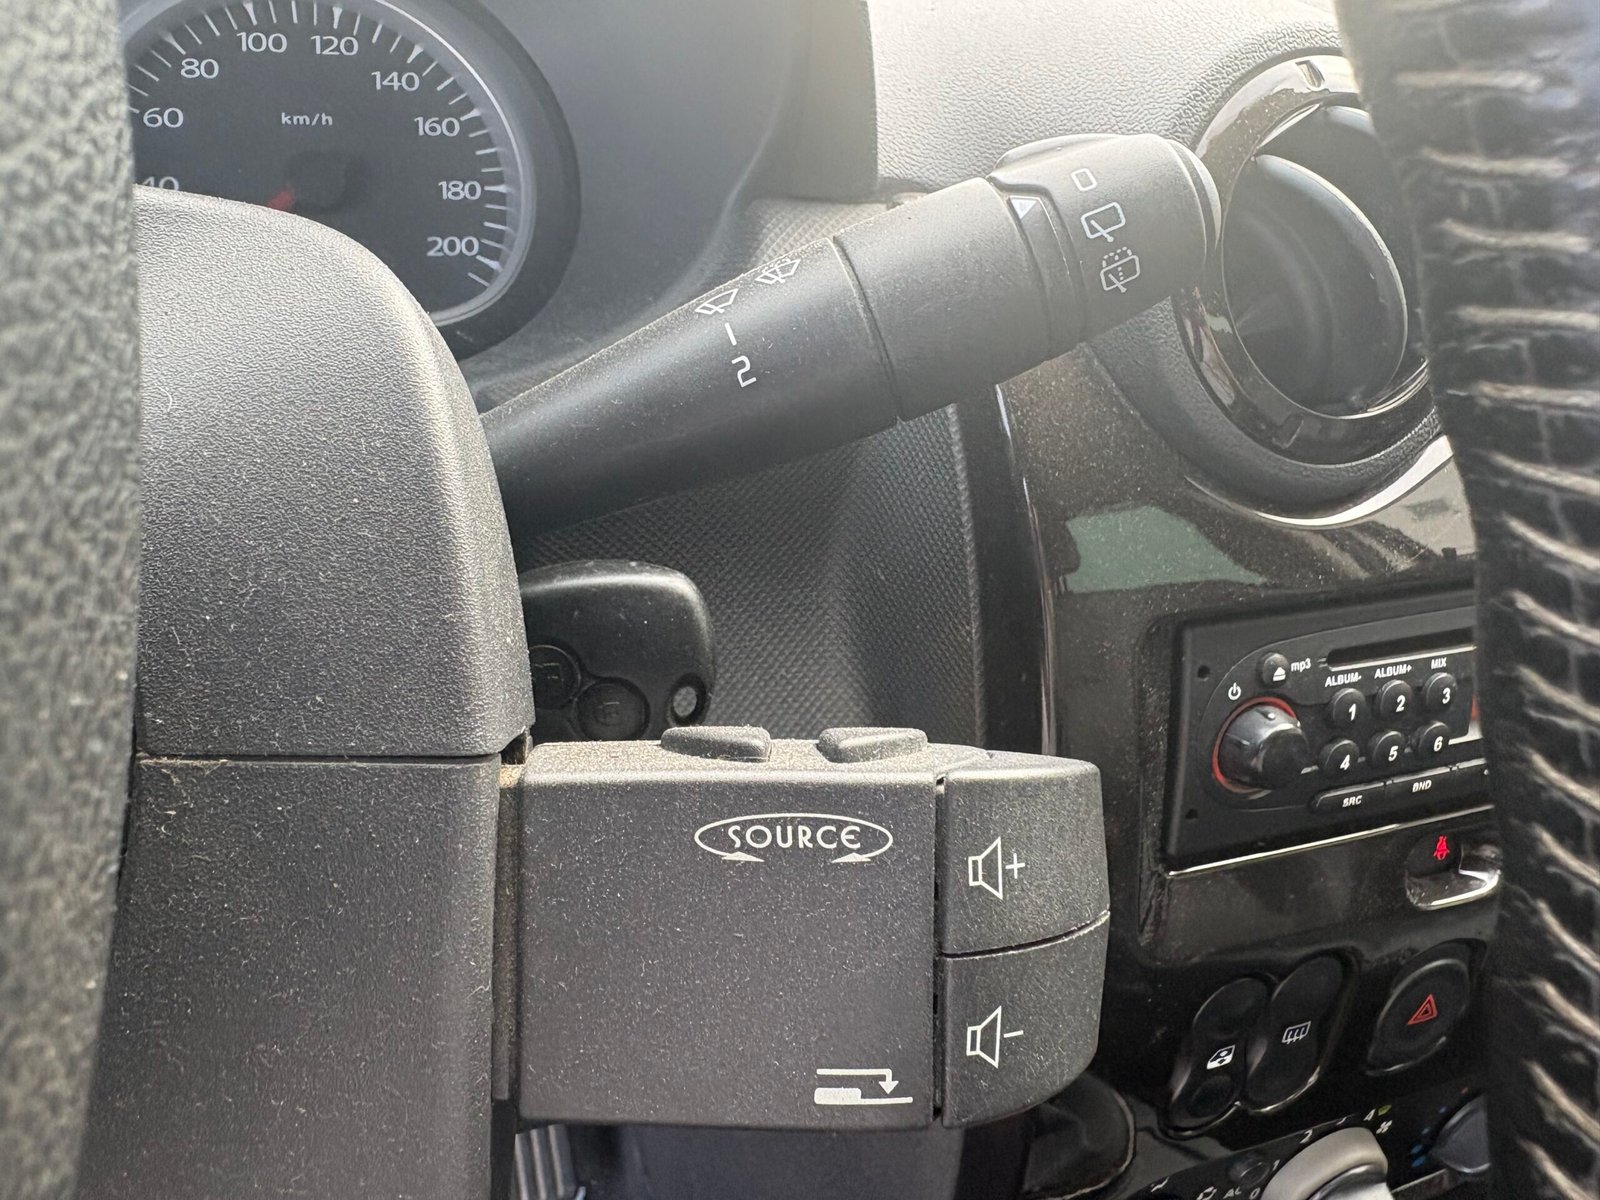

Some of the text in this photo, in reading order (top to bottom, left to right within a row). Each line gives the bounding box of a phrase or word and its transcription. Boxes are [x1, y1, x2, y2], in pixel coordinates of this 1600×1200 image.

[236, 31, 288, 54] 100
[309, 34, 359, 56] 120
[180, 58, 220, 79] 80
[371, 71, 420, 92] 140
[142, 107, 184, 129] 60
[281, 111, 334, 126] km/h
[414, 116, 461, 137] 160
[437, 180, 482, 201] 180
[426, 236, 480, 257] 200
[731, 355, 757, 388] 2
[1290, 658, 1312, 673] mp3
[1430, 657, 1448, 670] MIX
[1395, 694, 1406, 712] 2
[1441, 687, 1451, 704] 3
[1348, 703, 1357, 721] 1
[1387, 745, 1399, 762] 5
[1433, 736, 1443, 752] 6
[1339, 754, 1351, 771] 4
[726, 824, 862, 850] SOURCE
